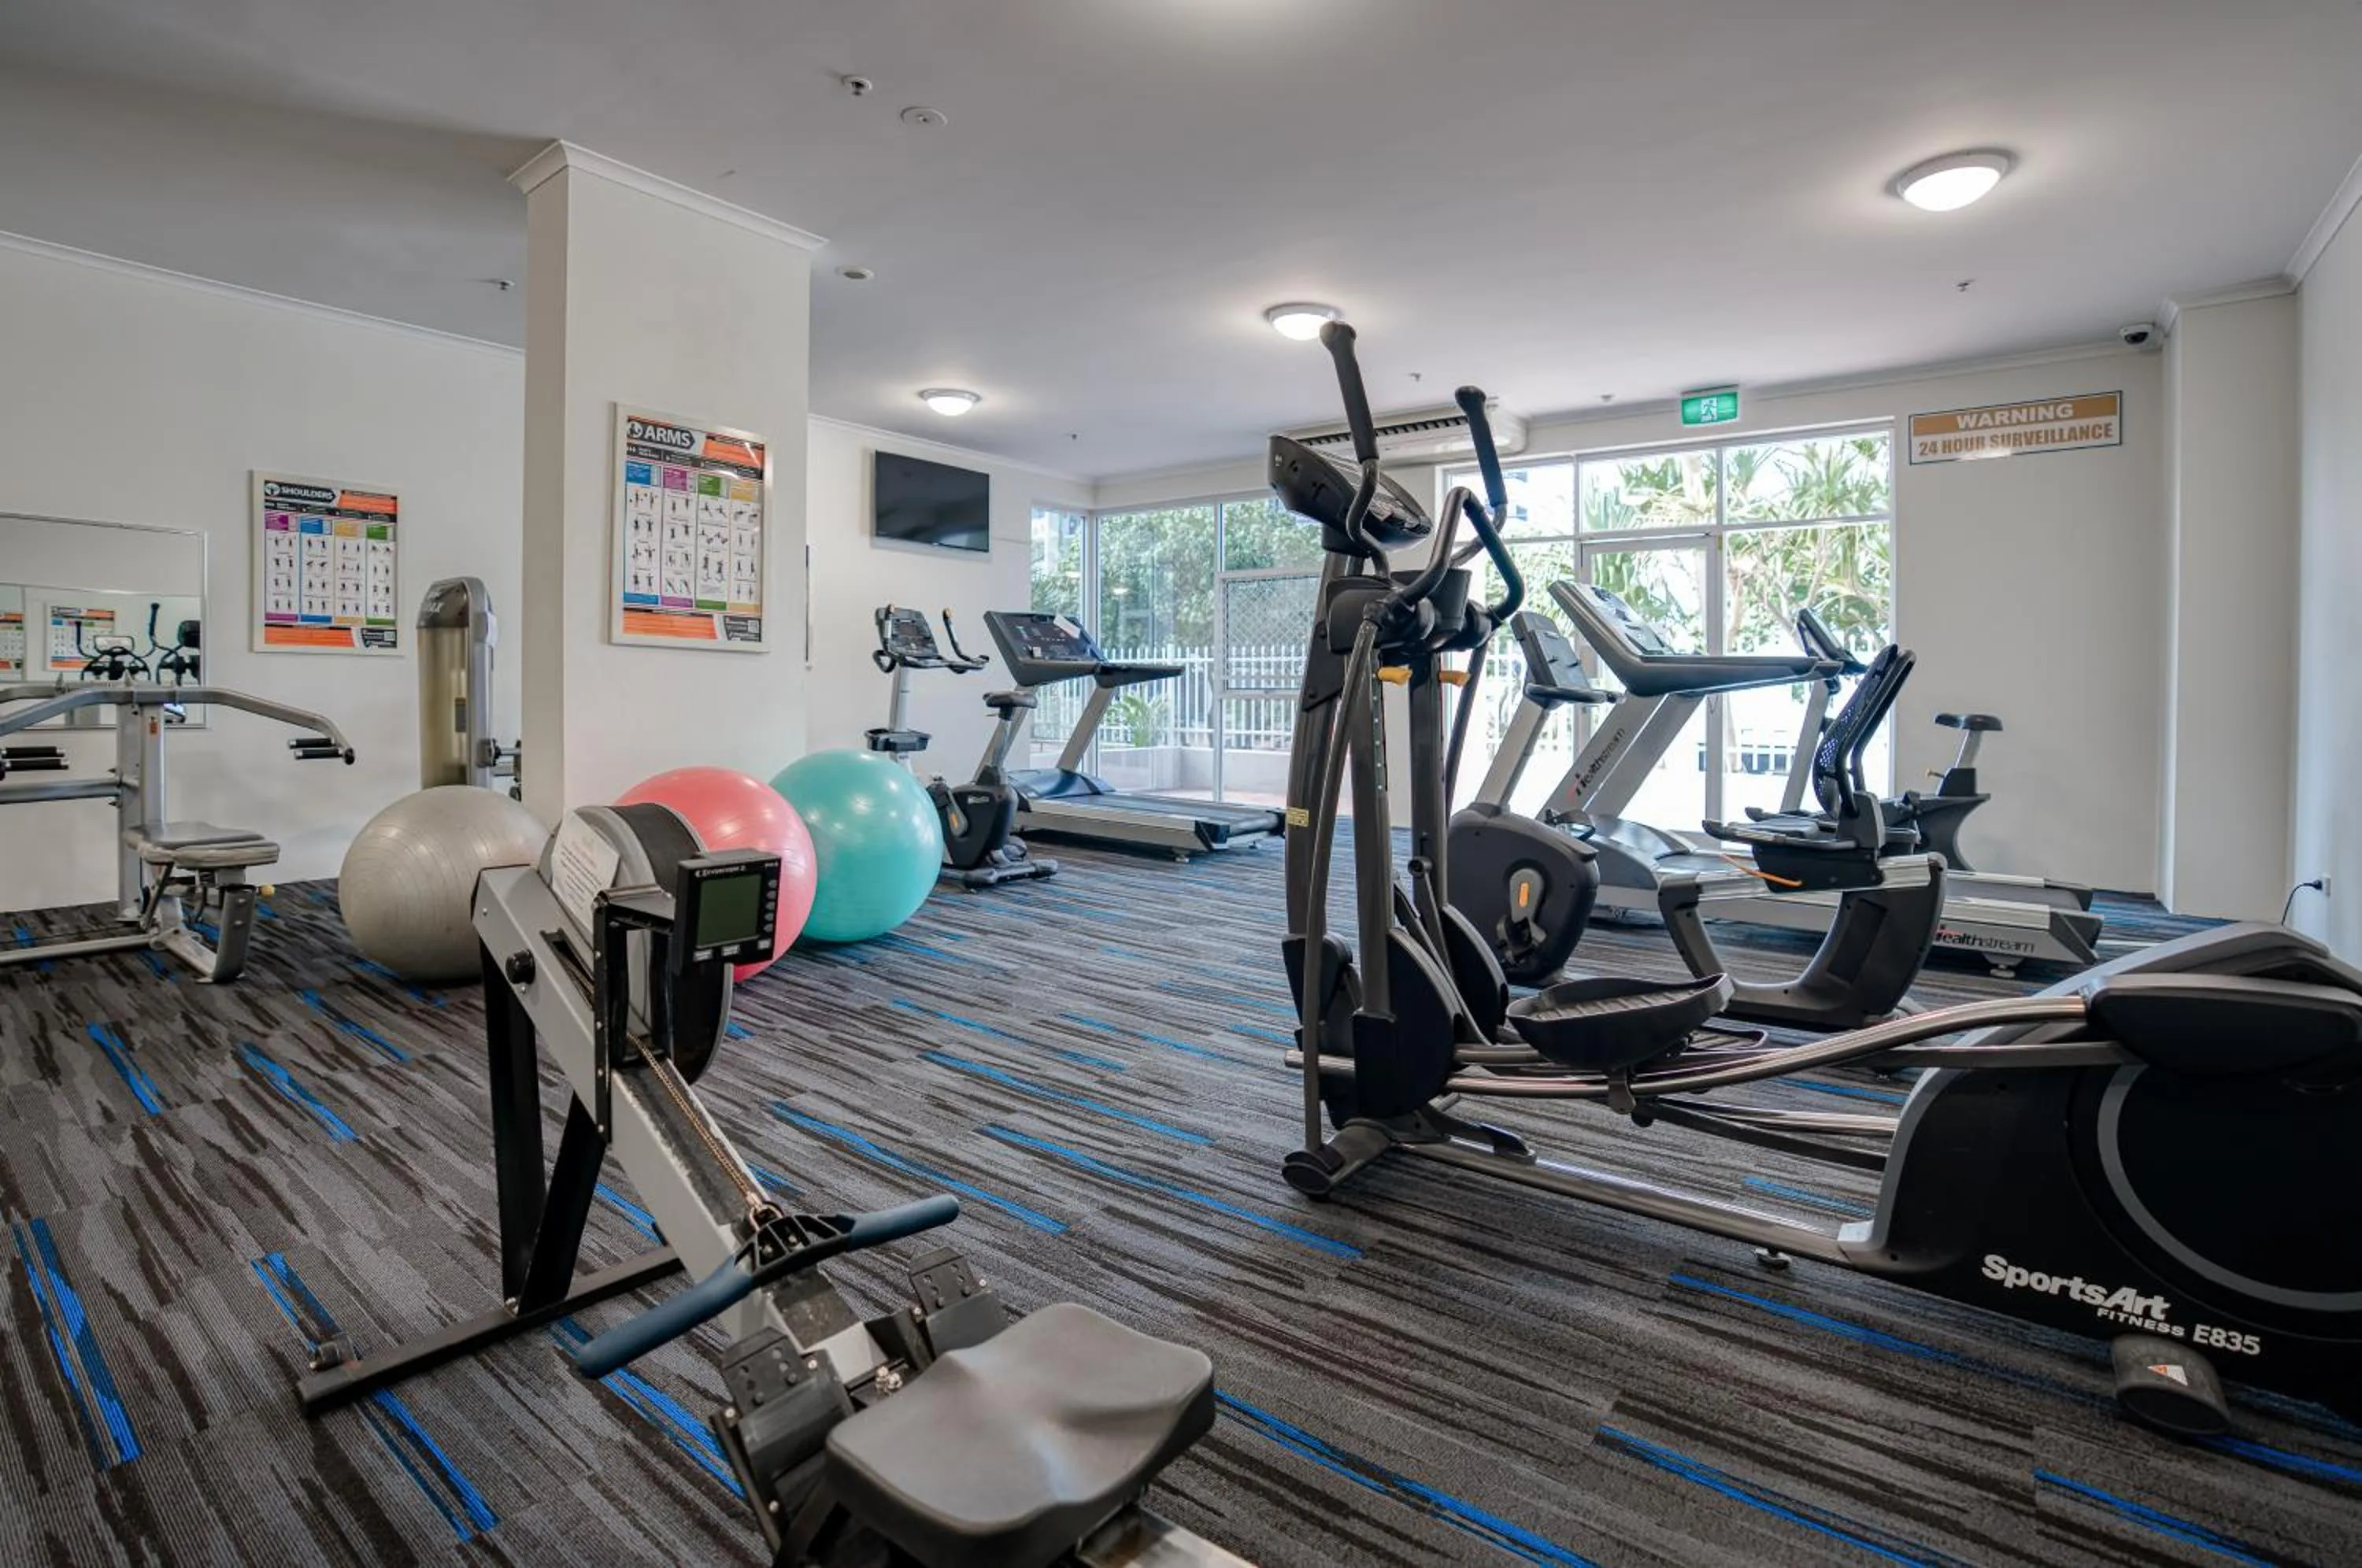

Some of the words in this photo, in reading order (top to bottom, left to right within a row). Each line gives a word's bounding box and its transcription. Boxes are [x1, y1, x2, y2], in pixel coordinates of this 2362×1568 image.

[1957, 404, 2074, 429] WARNING
[643, 425, 690, 447] ARMS
[1919, 442, 1938, 456] 24
[1942, 435, 1986, 454] HOUR
[1989, 423, 2113, 449] SURVEILLANCE
[1981, 1253, 2171, 1321] SportsArt
[2097, 1307, 2186, 1337] FITNESS
[2193, 1323, 2261, 1355] E835
